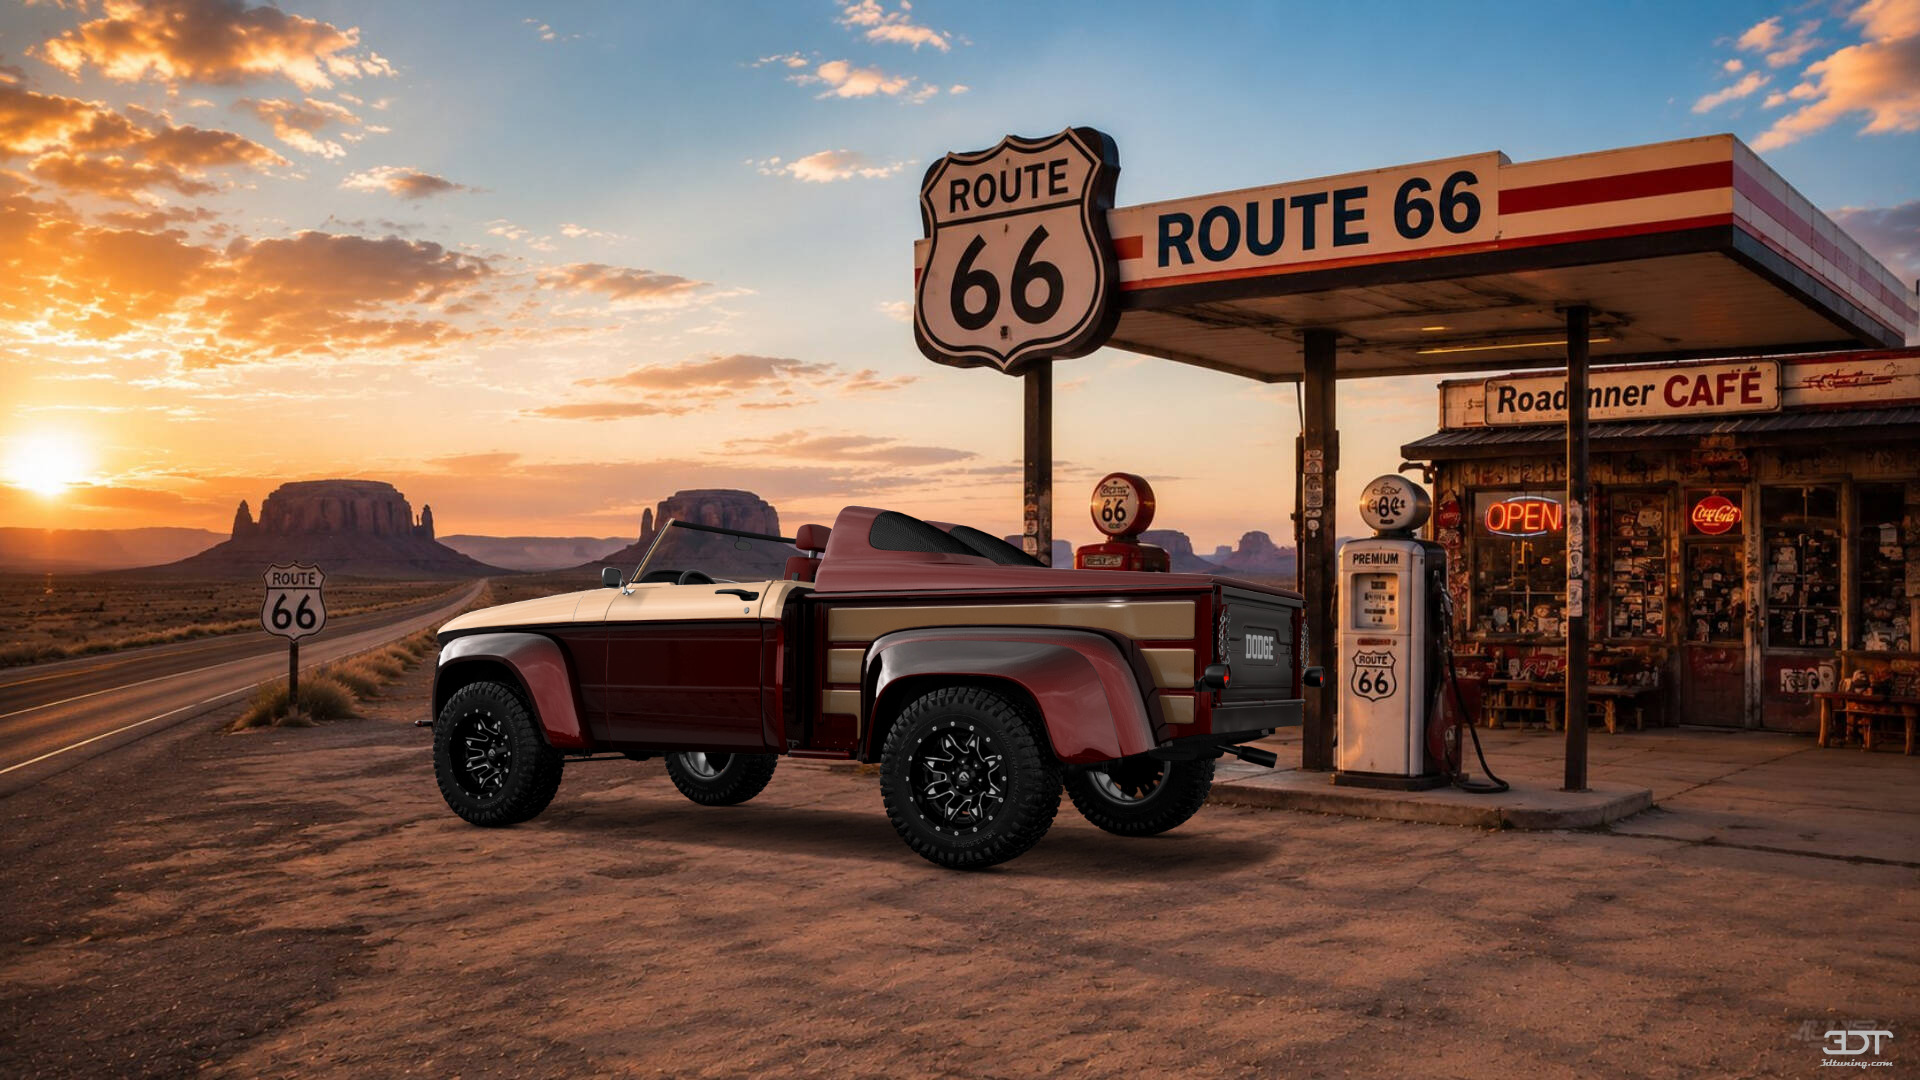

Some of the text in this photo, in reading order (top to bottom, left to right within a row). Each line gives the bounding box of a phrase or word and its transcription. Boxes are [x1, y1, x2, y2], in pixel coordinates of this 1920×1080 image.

[948, 158, 1069, 213] ROUTE
[1156, 170, 1482, 268] ROUTE 66
[950, 224, 1064, 331] 66
[1497, 382, 1655, 413] Roadnner
[1102, 499, 1127, 522] 66
[1487, 502, 1559, 530] OPEN
[1353, 553, 1398, 565] PREMIUM
[272, 572, 316, 585] ROUTE
[271, 593, 316, 630] 66
[1245, 634, 1274, 660] DODGE
[1358, 655, 1388, 666] ROUTE
[1358, 670, 1389, 694] 66
